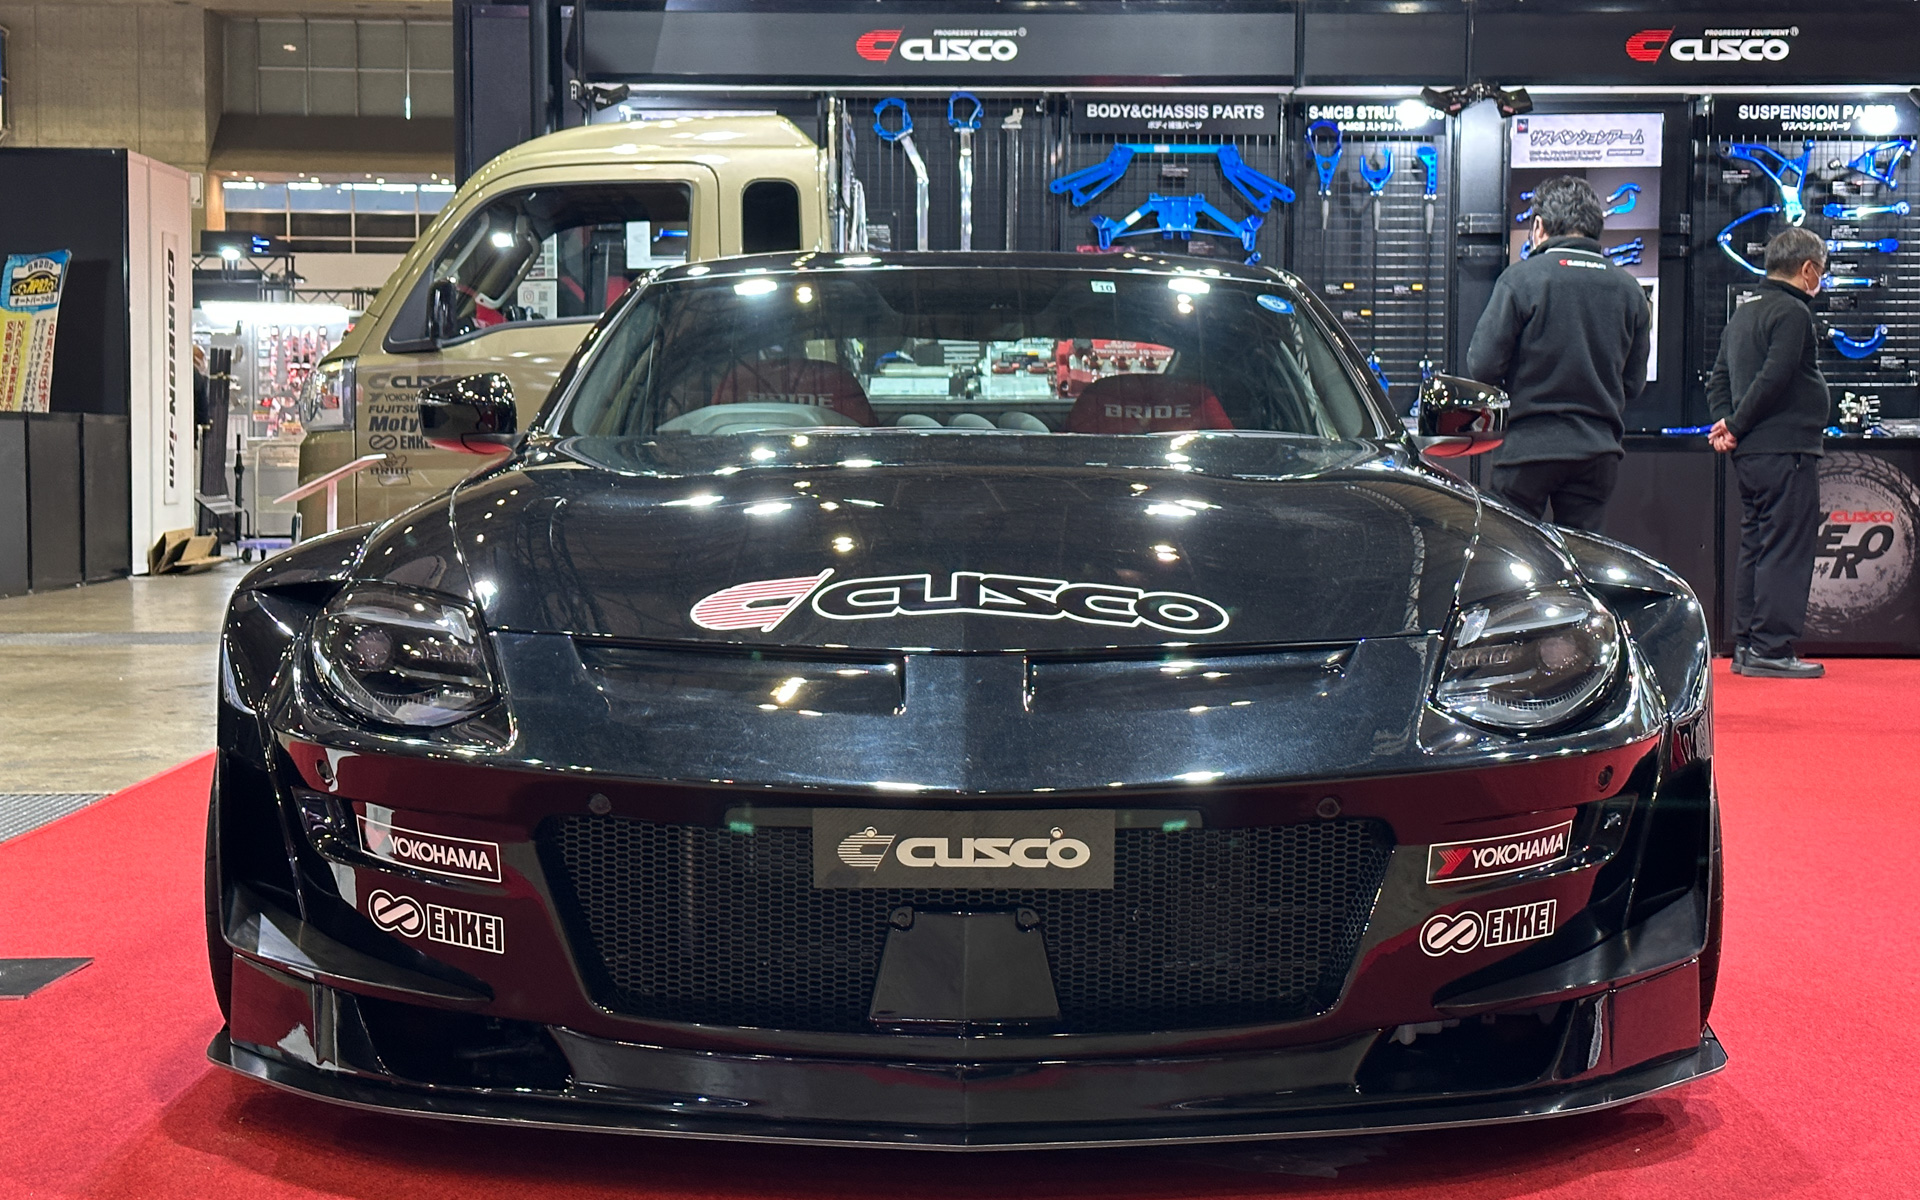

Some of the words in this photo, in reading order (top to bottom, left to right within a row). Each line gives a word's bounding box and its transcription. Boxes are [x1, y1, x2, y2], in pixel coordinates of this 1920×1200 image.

[933, 28, 978, 37] PROGRESSIVE
[979, 28, 1018, 37] EQUIPMENT
[1704, 28, 1750, 37] PROGRESSIVE
[1751, 28, 1789, 37] EQUIPMENT
[900, 38, 1018, 62] CUSCO
[1669, 38, 1790, 62] CUSCO
[1086, 103, 1209, 119] BODY&CHASSIS
[1212, 103, 1265, 119] PARTS
[1308, 105, 1354, 120] S-MCB
[1738, 104, 1840, 120] SUSPENSION
[1529, 128, 1645, 147] サスペンションアーム
[1104, 403, 1192, 419] BRIDE
[1830, 510, 1895, 523] CUSCO
[811, 570, 1231, 635] CUSCO
[388, 833, 493, 873] YOKOHAMA
[895, 836, 1091, 869] CUSCO
[1472, 832, 1564, 869] YOKOHAMA
[426, 903, 505, 955] ENKEI
[1483, 898, 1557, 948] ENKEI
